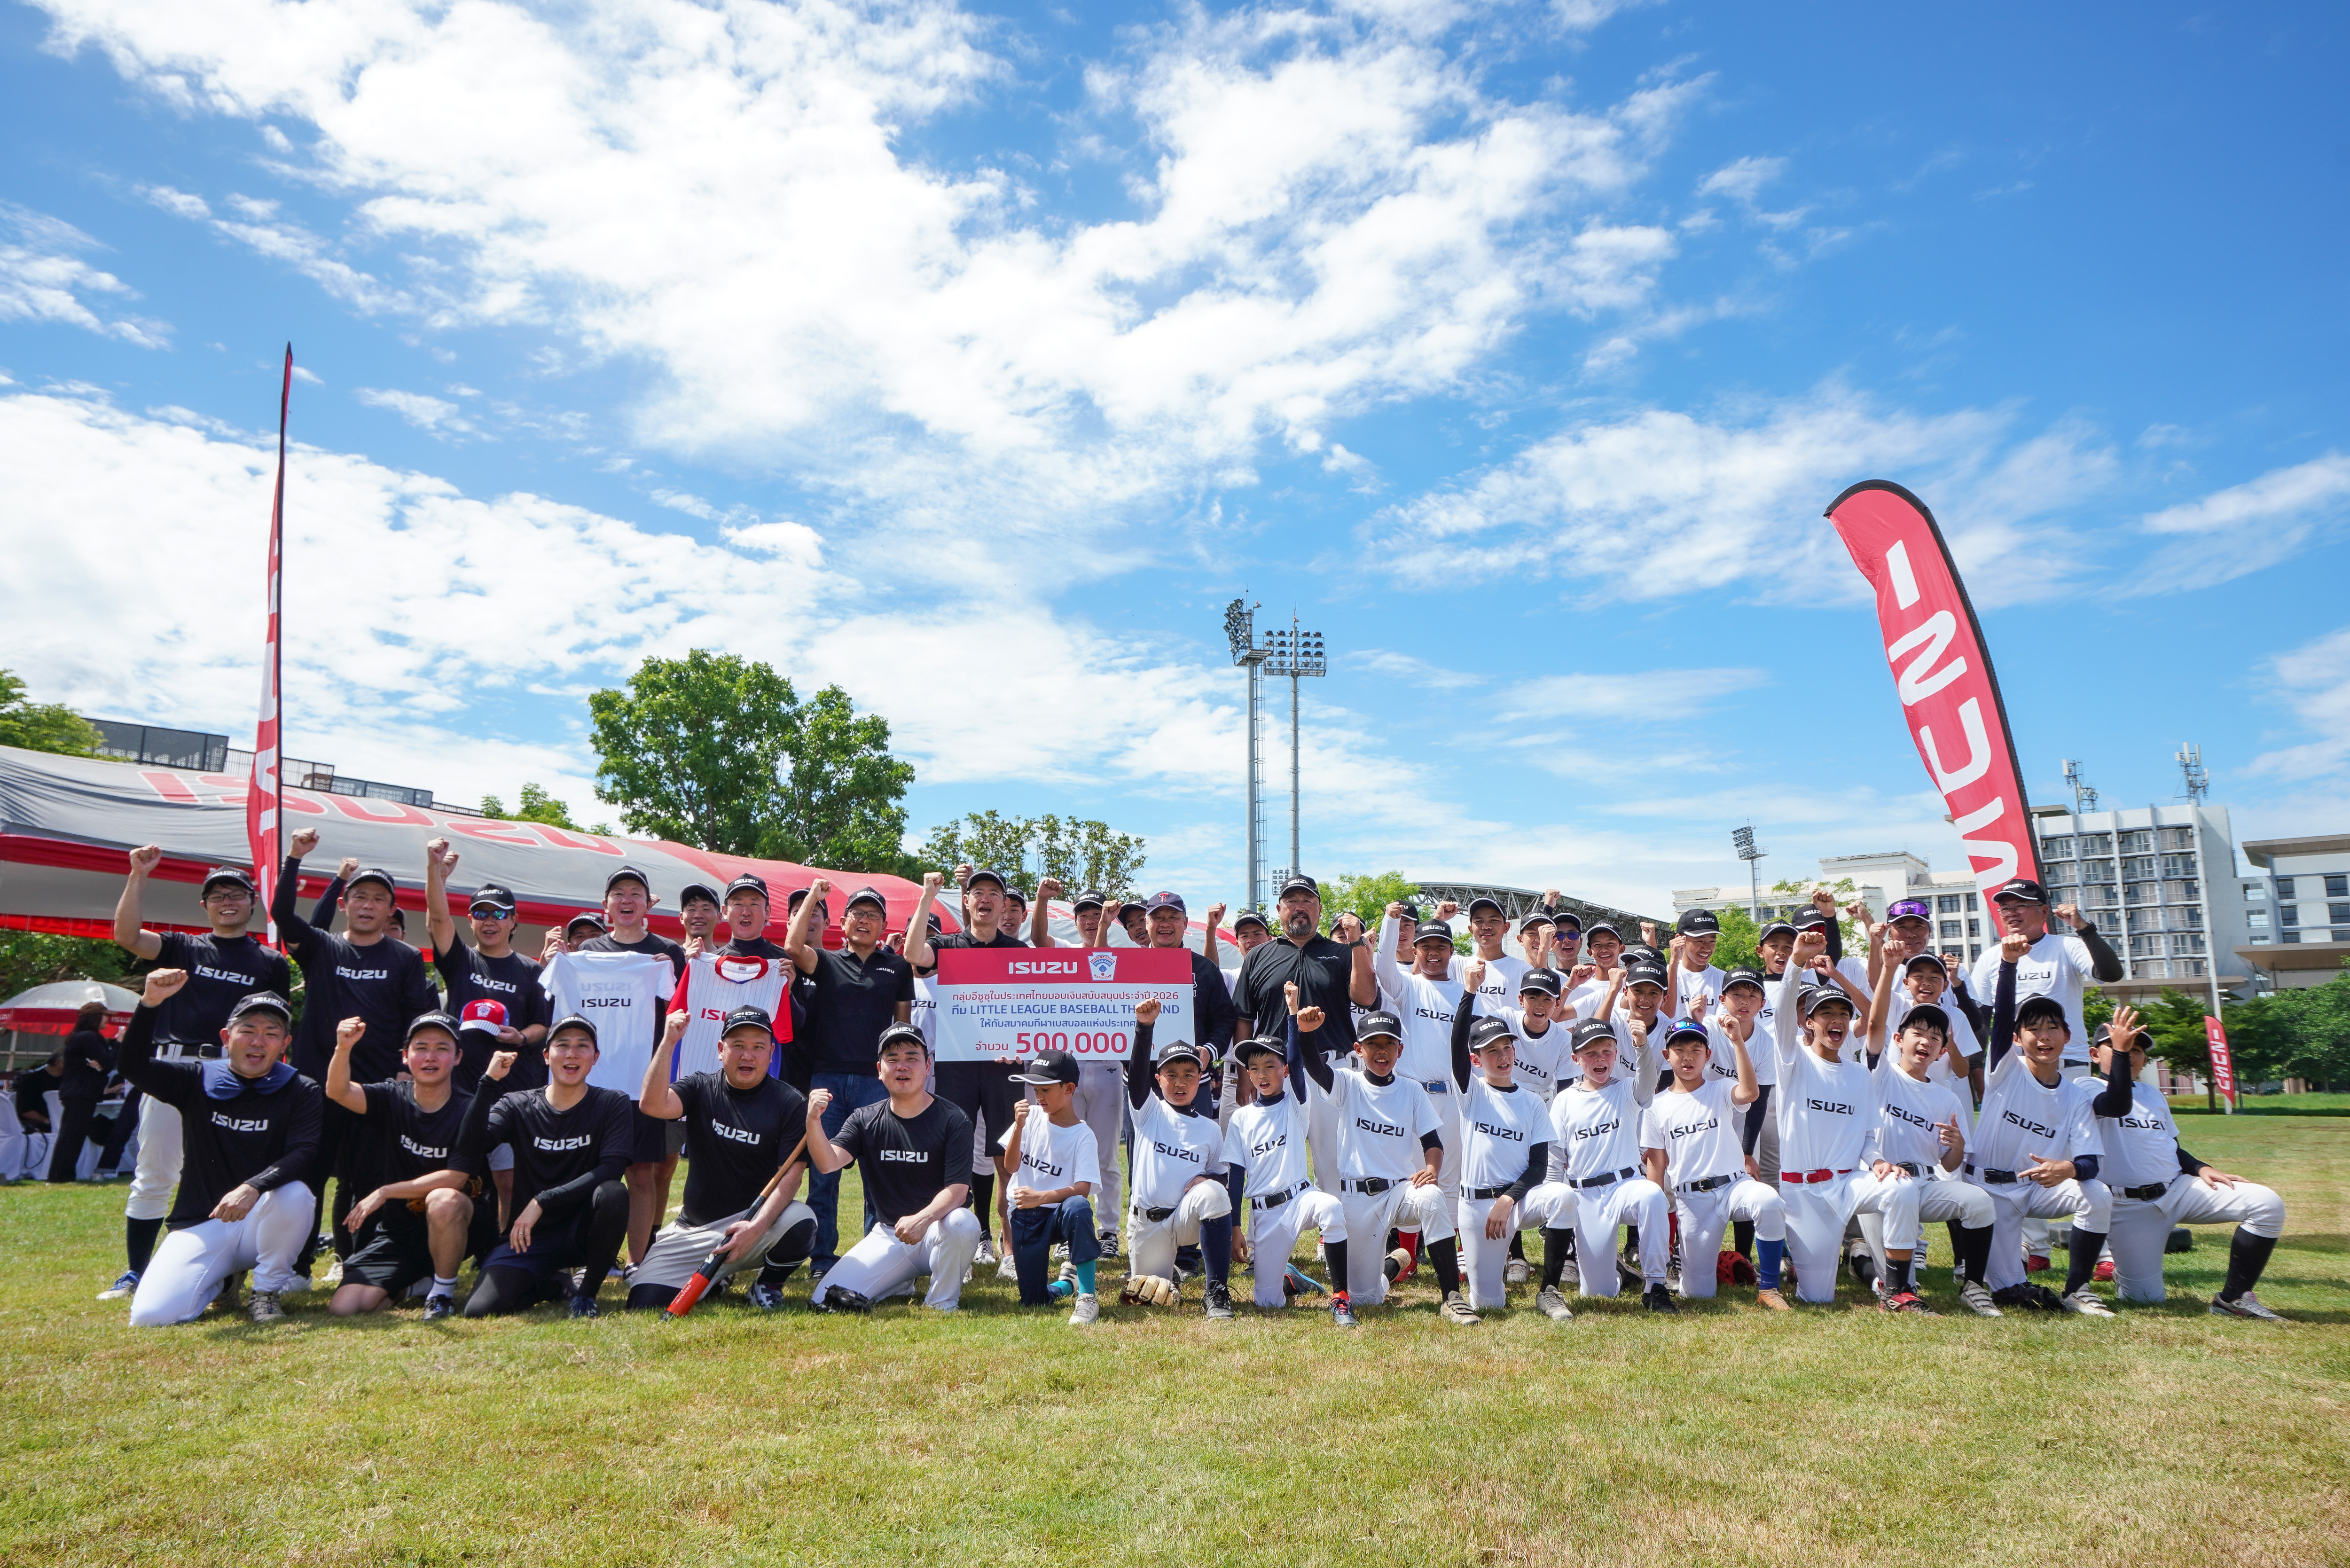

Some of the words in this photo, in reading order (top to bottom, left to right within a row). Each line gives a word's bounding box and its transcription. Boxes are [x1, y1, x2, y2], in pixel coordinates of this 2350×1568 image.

[1009, 962, 1078, 974] ISUZU
[1093, 959, 1113, 967] THAILAND
[1636, 966, 1661, 975] ISUZU
[195, 965, 255, 986] ISUZU
[336, 966, 387, 980] ISUZU
[2018, 971, 2051, 980] UZU
[470, 973, 516, 993] ISUZU
[1152, 991, 1179, 1000] 2026
[1816, 989, 1844, 997] ISUZU
[581, 998, 631, 1008] ISUZU
[952, 1004, 967, 1015] ทีม
[970, 1004, 1008, 1015] LITTLE
[1011, 1004, 1057, 1014] LEAGUE
[1060, 1004, 1119, 1014] BASEBALL
[887, 1027, 915, 1036] ISUZU
[1479, 1021, 1504, 1031] ISUZU
[1582, 1024, 1606, 1033] ISUZU
[976, 1041, 1009, 1051] จำนวน
[1016, 1032, 1127, 1054] 500,000
[1807, 1098, 1856, 1115] ISUZU
[211, 1111, 269, 1132] ISUZU
[1886, 1103, 1935, 1132] ISUZU
[2003, 1110, 2056, 1139] ISUZU
[712, 1118, 760, 1145] ISUZU
[1356, 1117, 1405, 1137] ISUZU
[1474, 1121, 1524, 1142] ISUZU
[1574, 1118, 1620, 1141] ISUZU
[1669, 1118, 1719, 1140] ISUZU
[400, 1134, 447, 1158] ISUZU
[533, 1134, 591, 1151] ISUZU
[880, 1150, 928, 1163] ISUZU
[1153, 1141, 1200, 1163] ISUZU
